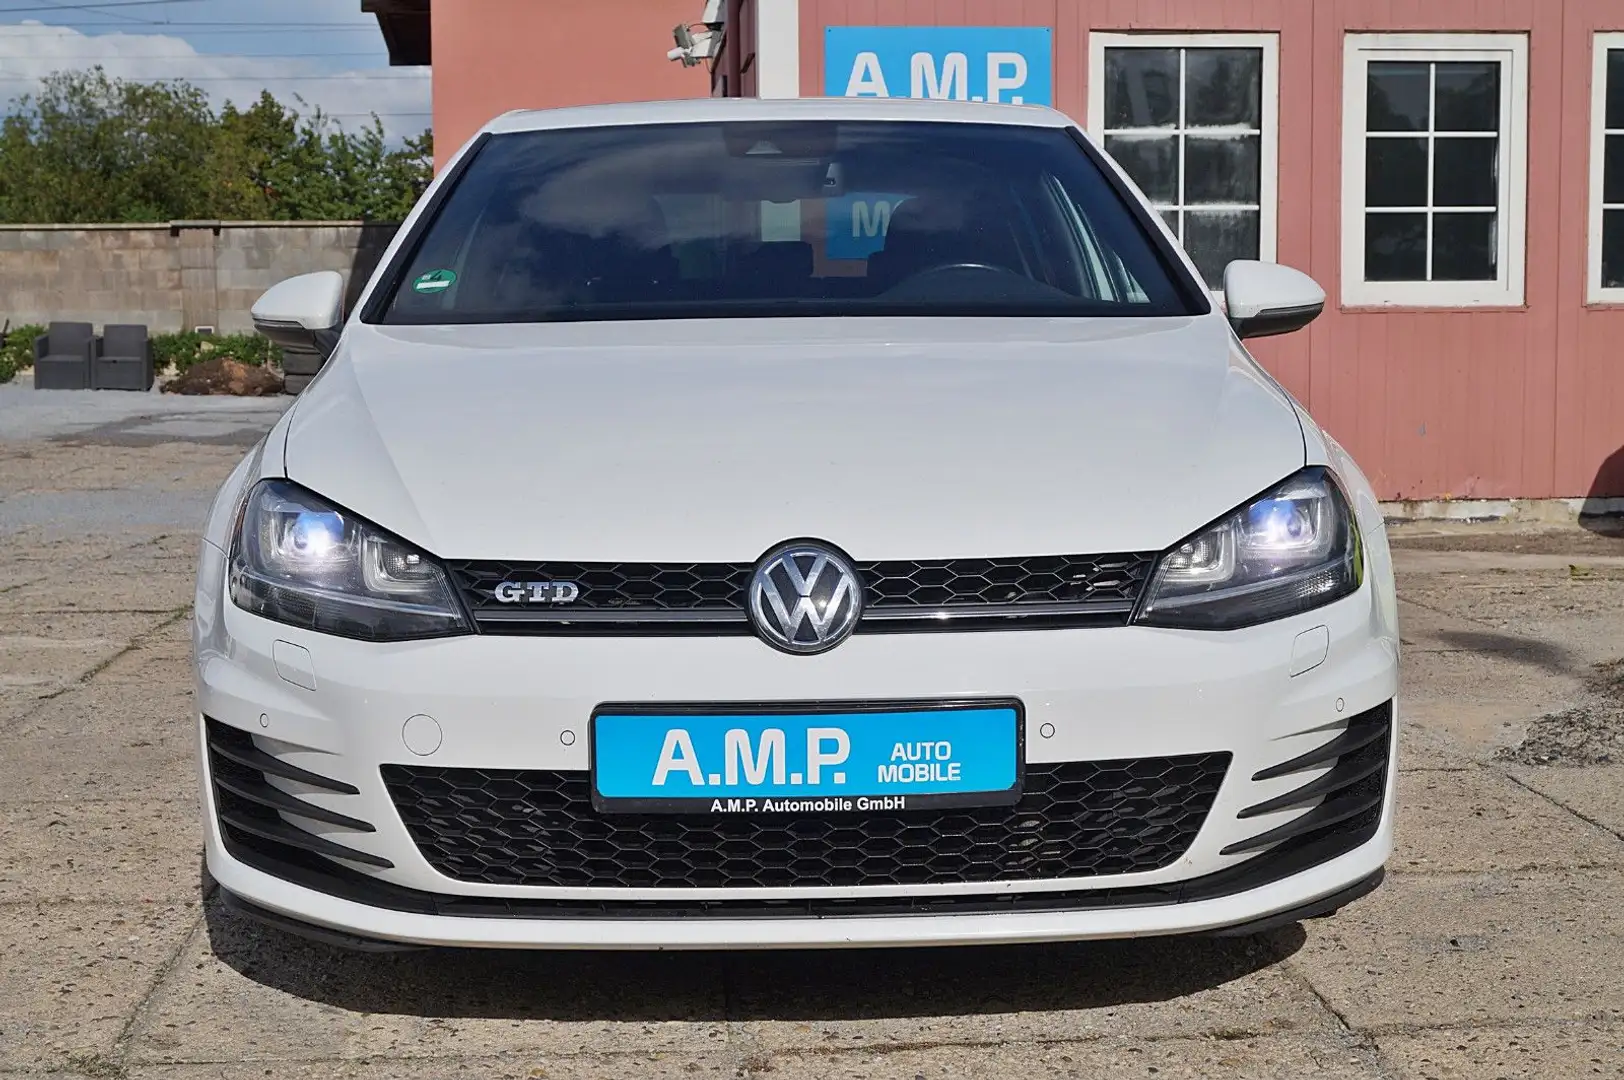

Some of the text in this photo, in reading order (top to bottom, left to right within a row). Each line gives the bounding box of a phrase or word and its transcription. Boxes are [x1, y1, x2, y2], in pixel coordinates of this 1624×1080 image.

[494, 581, 579, 603] GTD
[758, 552, 852, 643] VW
[652, 727, 851, 786] A.M.P.
[891, 741, 951, 761] AUTO
[878, 762, 961, 783] MOBILE
[711, 795, 906, 813] A.M.P. Automobile GmbH
